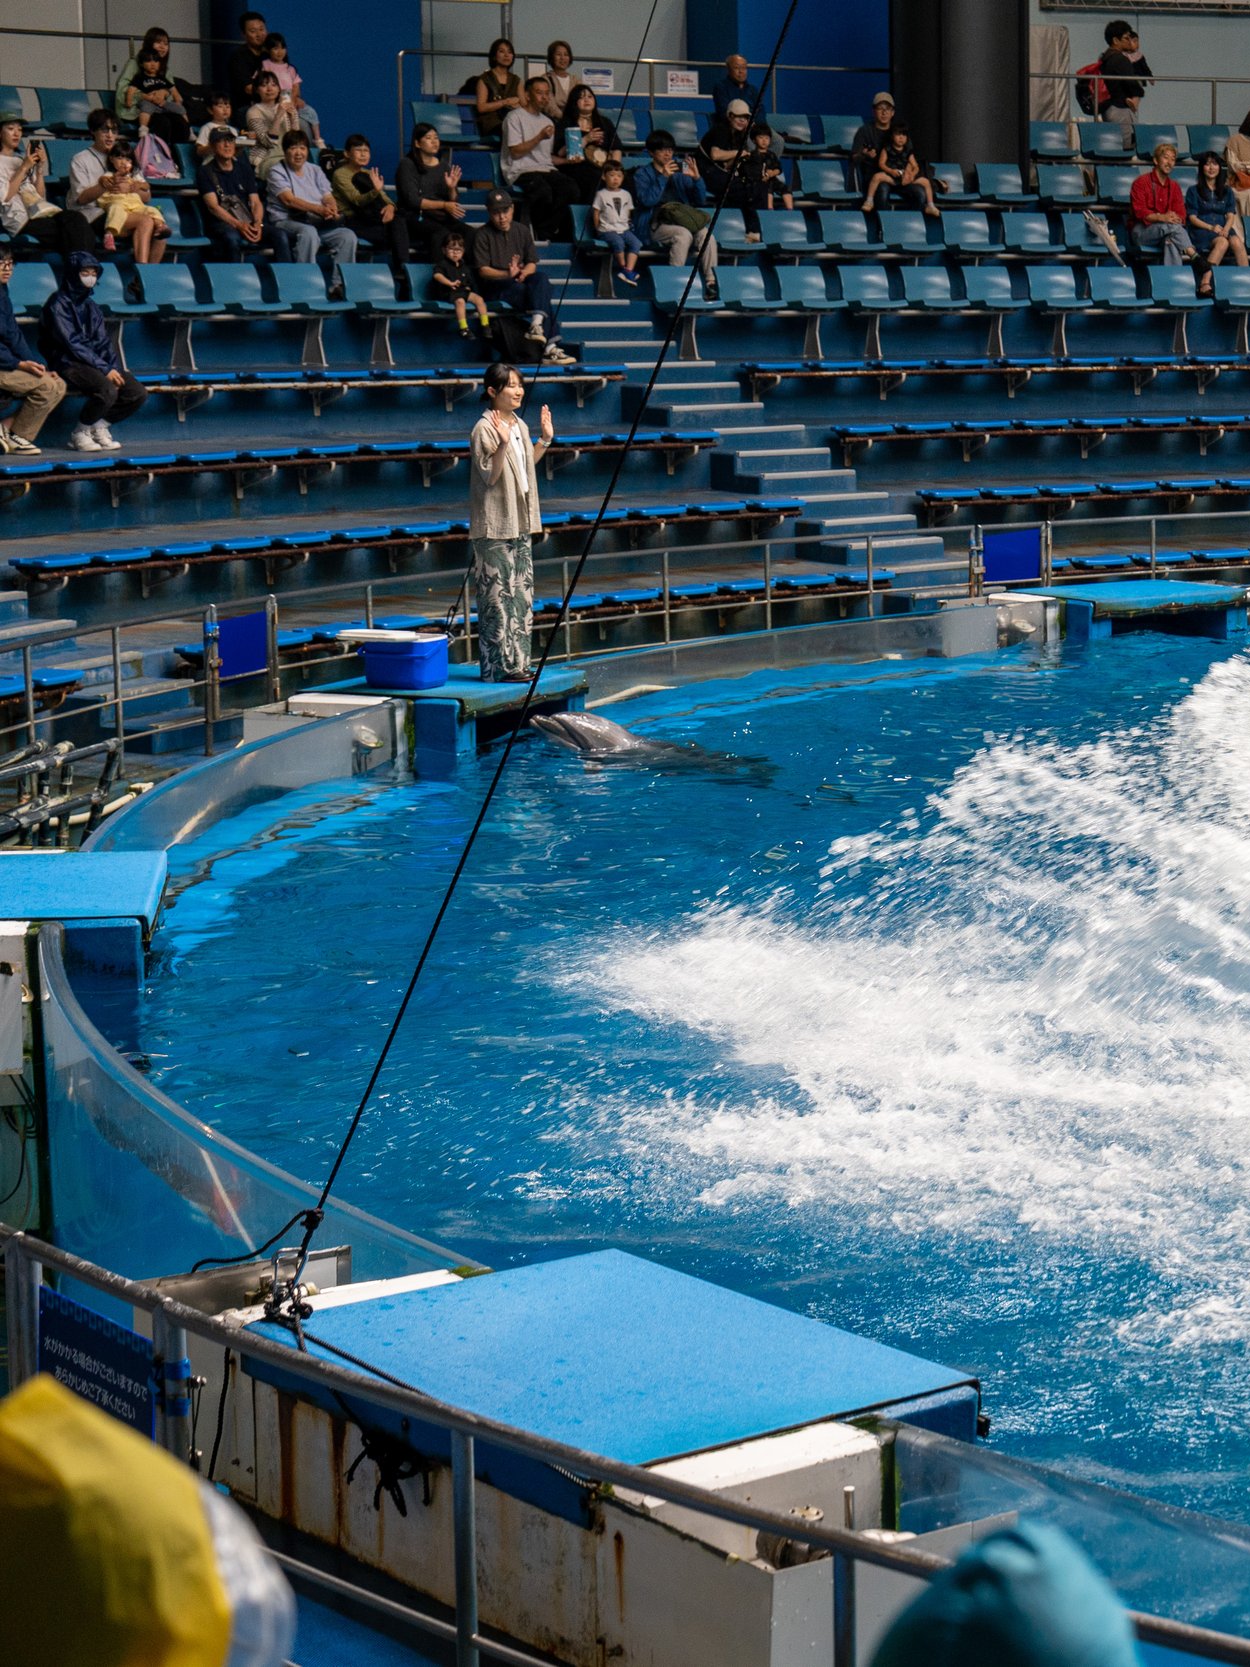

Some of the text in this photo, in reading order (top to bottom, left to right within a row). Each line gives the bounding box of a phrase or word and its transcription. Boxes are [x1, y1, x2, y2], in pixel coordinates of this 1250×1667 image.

[43, 1335, 148, 1402] 水がかかる場合がございますので
[54, 1364, 136, 1420] あらかじめご了承ください
